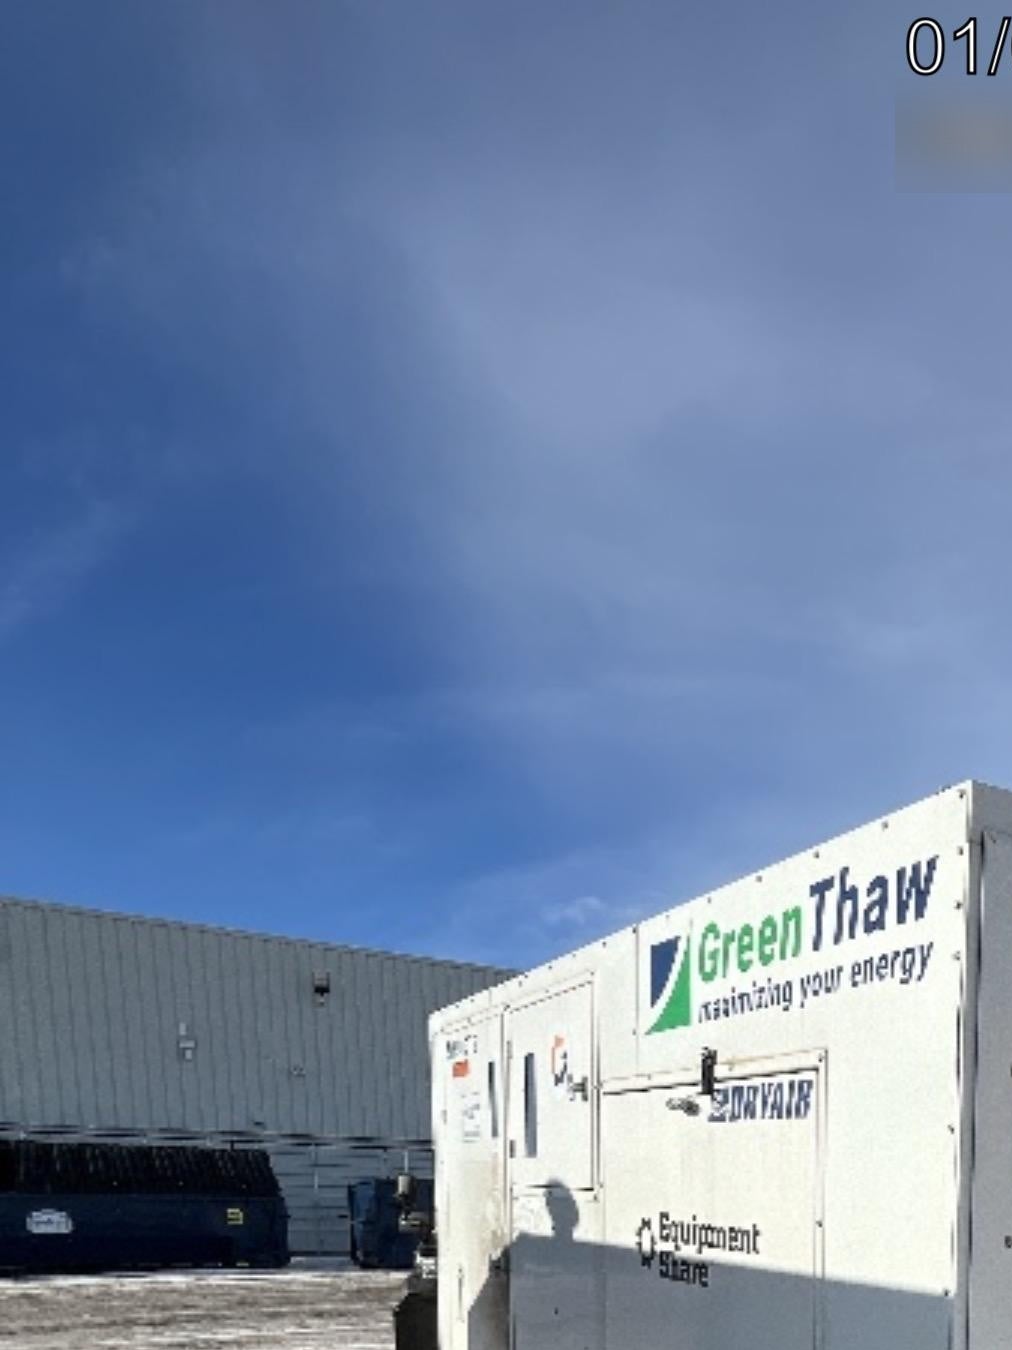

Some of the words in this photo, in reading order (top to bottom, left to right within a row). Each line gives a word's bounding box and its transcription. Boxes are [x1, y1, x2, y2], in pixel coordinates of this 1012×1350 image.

[698, 977, 793, 1022] maximizing
[800, 965, 843, 1008] your
[850, 941, 934, 989] energy
[659, 1211, 760, 1255] Equipment
[659, 1250, 709, 1288] Share
